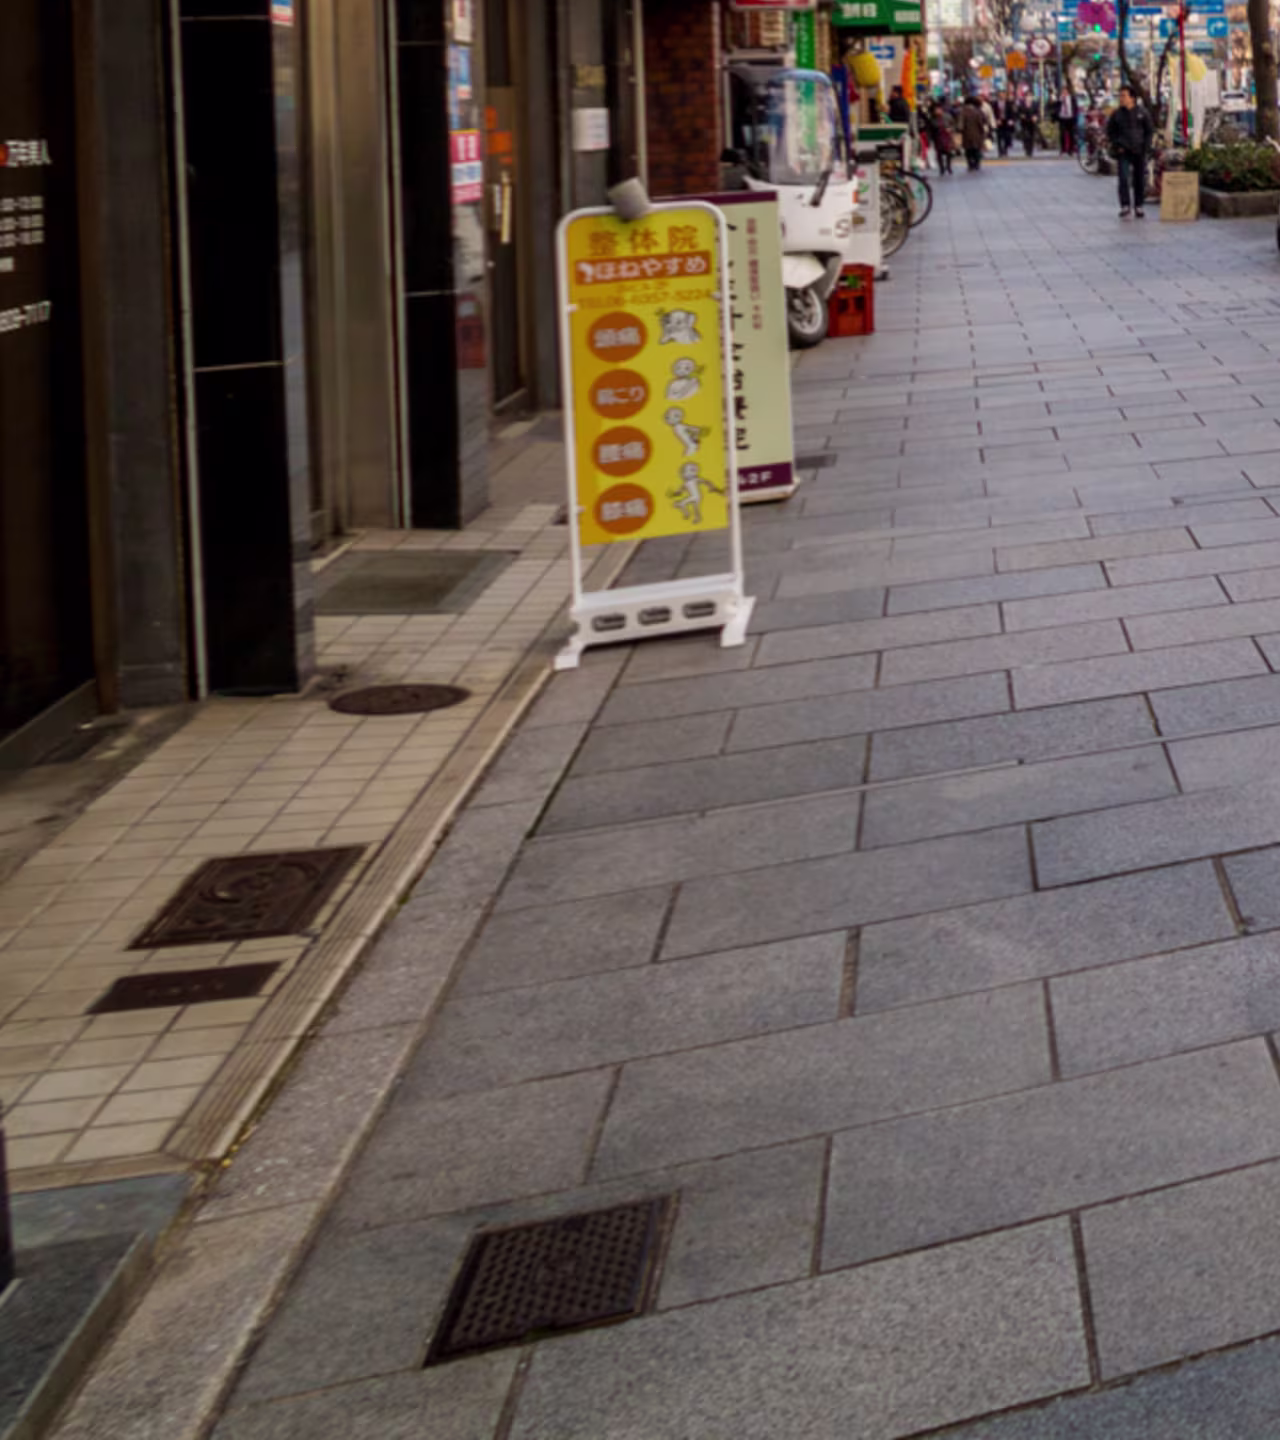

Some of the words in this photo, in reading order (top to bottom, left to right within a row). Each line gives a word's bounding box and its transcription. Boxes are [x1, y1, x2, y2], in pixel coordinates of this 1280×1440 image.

[588, 224, 700, 257] 整体院
[595, 255, 708, 281] ほねやすめ
[596, 385, 646, 406] 肩こり
